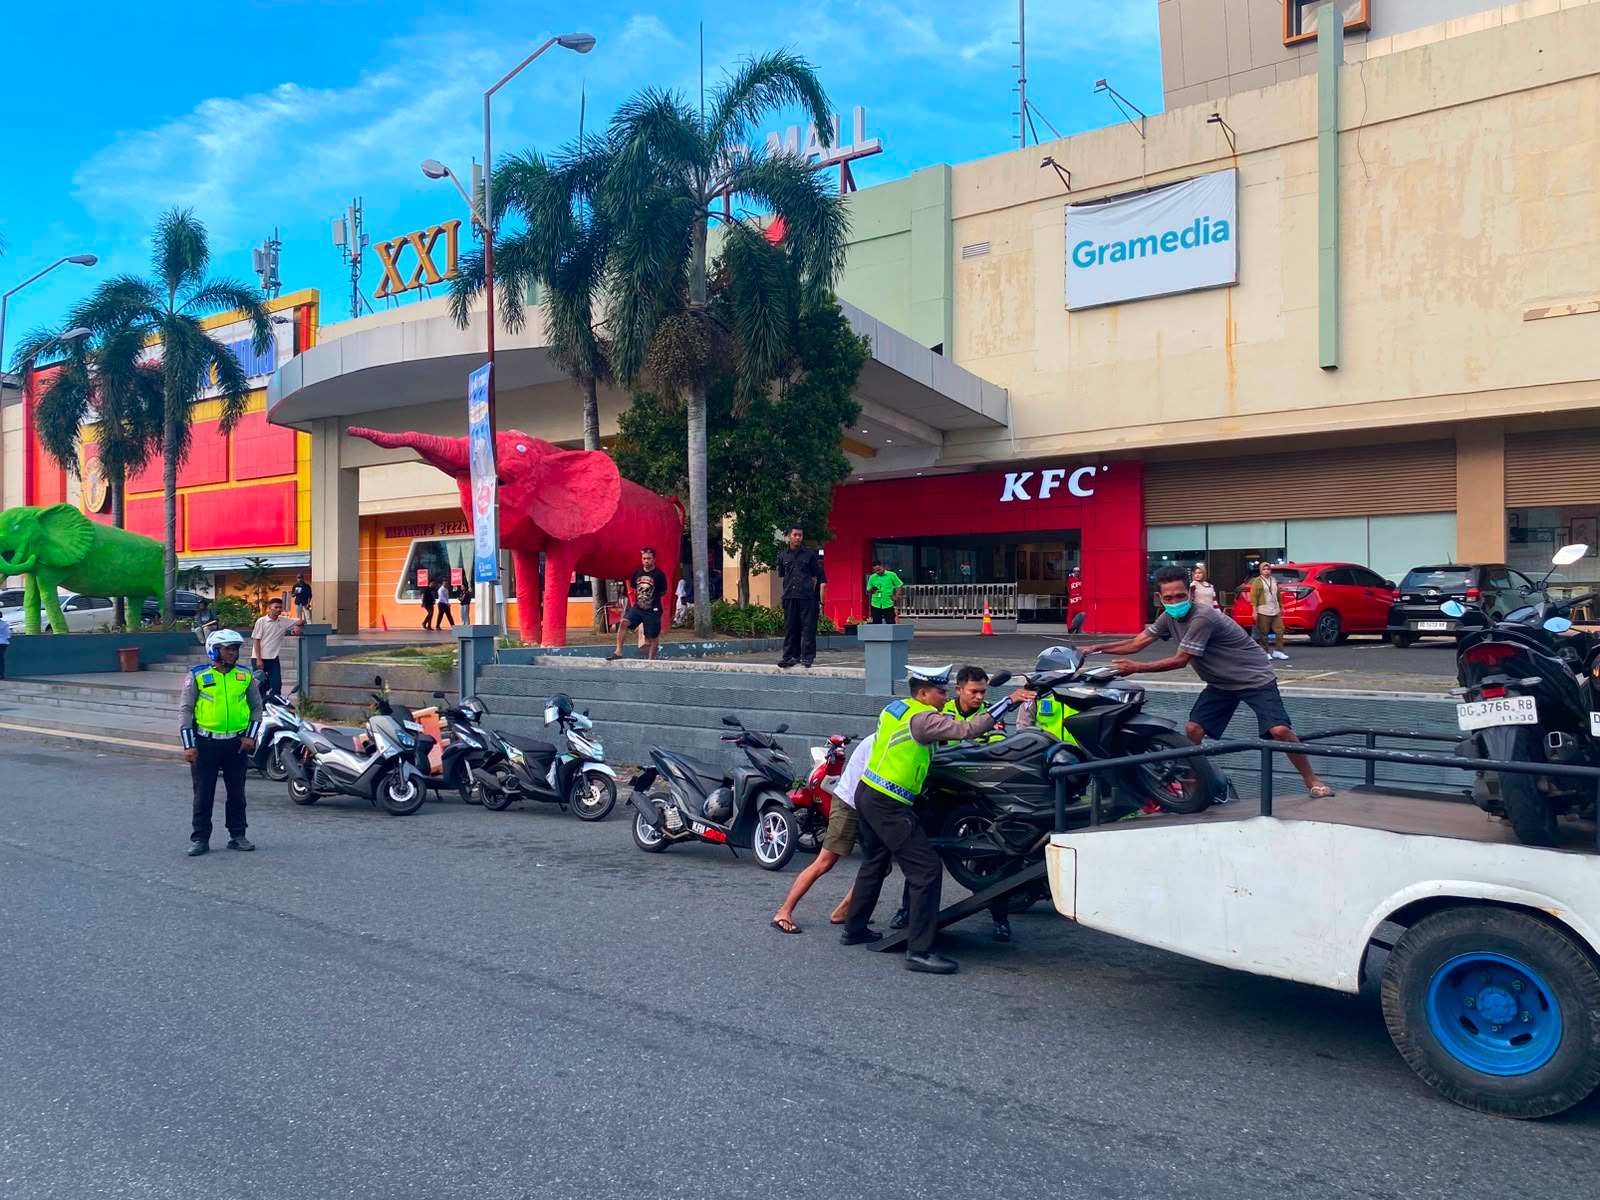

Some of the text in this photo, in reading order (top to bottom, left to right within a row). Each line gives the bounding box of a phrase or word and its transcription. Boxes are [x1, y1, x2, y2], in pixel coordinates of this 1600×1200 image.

[766, 106, 882, 166] MALL
[373, 219, 462, 298] XXI
[1072, 216, 1230, 268] Gramedia
[1000, 466, 1096, 502] KFC
[440, 521, 468, 534] PIZZA
[1460, 699, 1533, 717] DG 3766 RB
[1593, 713, 1600, 723] D
